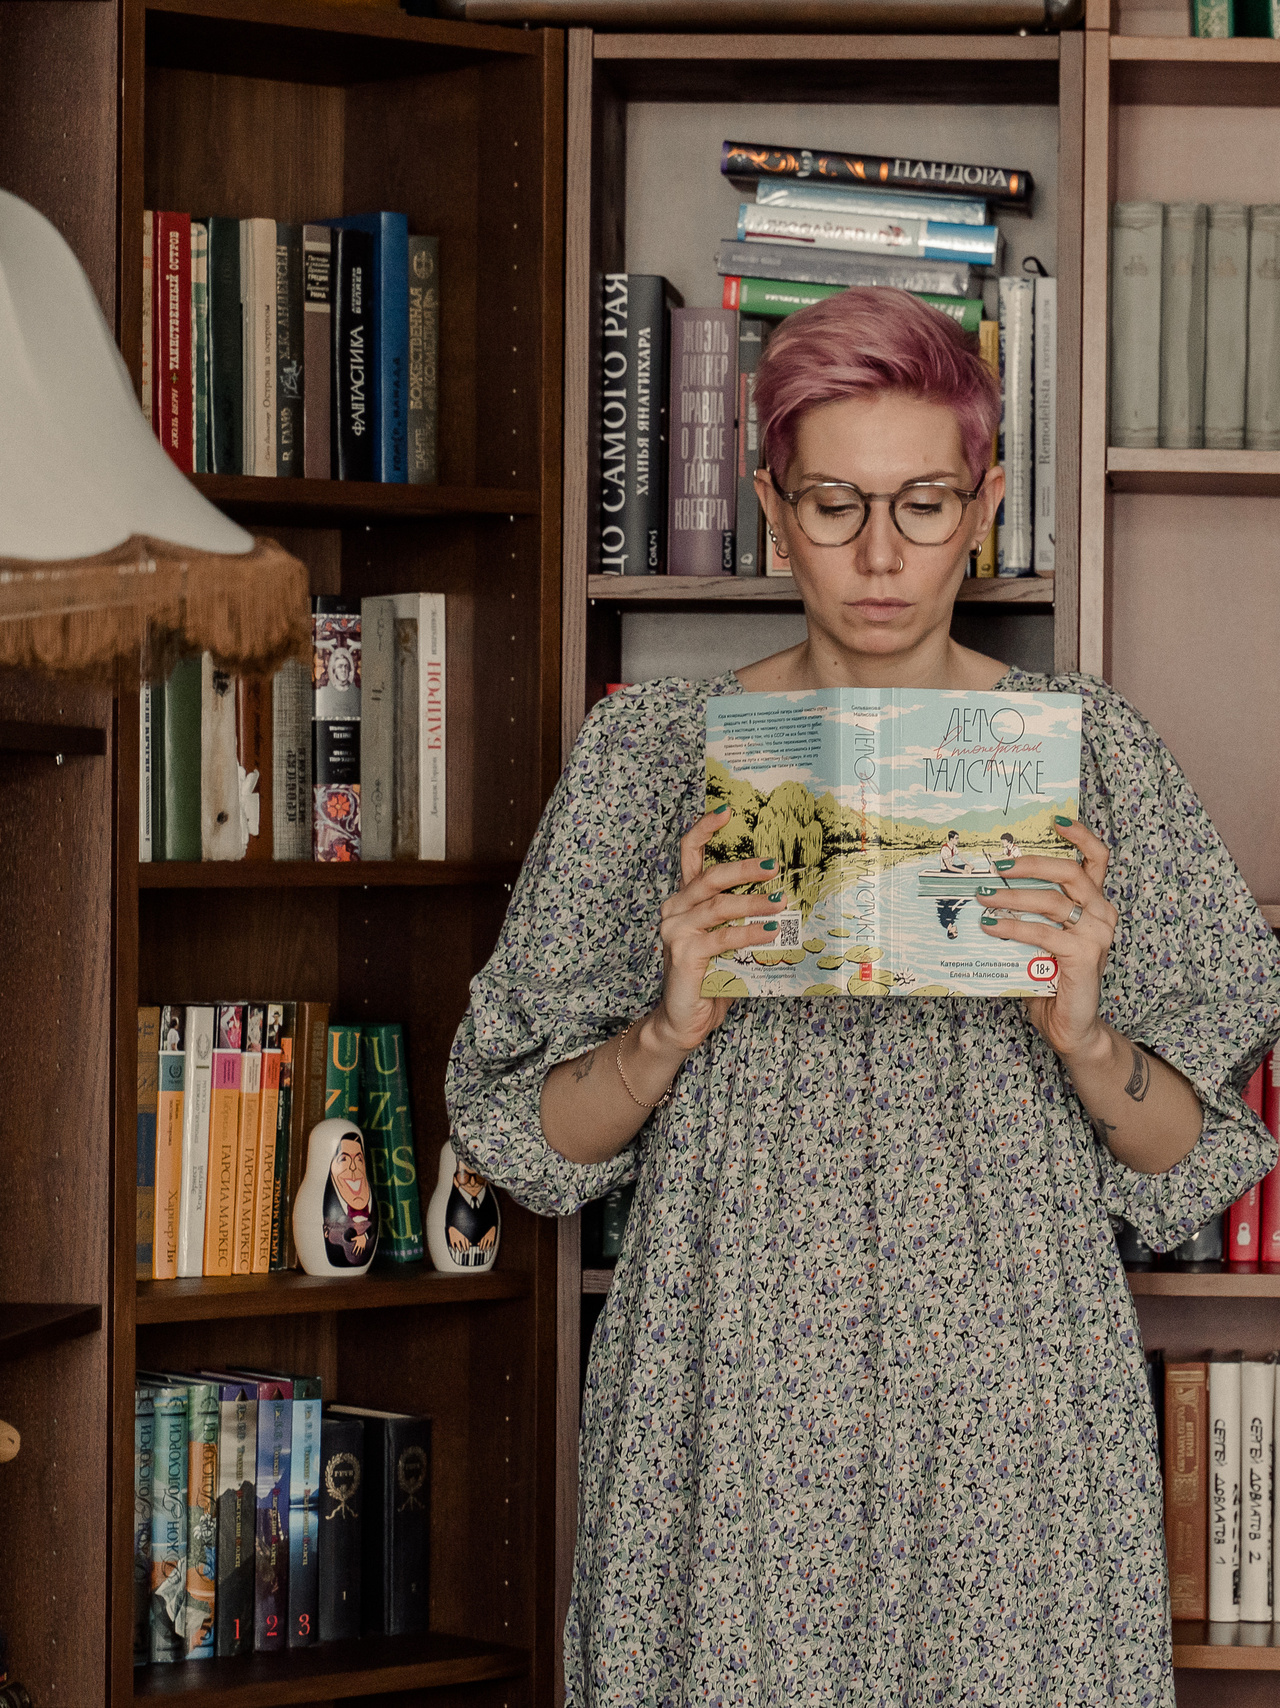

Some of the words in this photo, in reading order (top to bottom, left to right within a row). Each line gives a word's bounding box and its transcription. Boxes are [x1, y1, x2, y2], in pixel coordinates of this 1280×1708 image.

[893, 158, 1007, 187] ПАНДОРА
[169, 230, 179, 271] ОСТРОВ
[277, 245, 289, 327] АНДЕРСЕН
[604, 273, 629, 338] РАЯ
[166, 274, 180, 370] ТАИНСТВЕННЫЙ
[263, 304, 272, 353] островом
[264, 355, 271, 366] за
[410, 287, 423, 410] БОЖЕСТВЕННАЯ
[263, 369, 272, 408] Остров
[350, 325, 366, 436] ФАНТАСТИКА
[637, 326, 652, 431] ЯНАГИХАРА
[171, 389, 179, 415] ВЕРН
[681, 391, 725, 426] ПРАВДА
[1038, 378, 1052, 466] Remodelista
[602, 351, 626, 513] САМОГО
[681, 428, 689, 459] О
[692, 426, 725, 464] ДЕЛЕ
[636, 437, 650, 496] ХАНЬЯ
[684, 464, 720, 494] ГАРРИ
[674, 498, 729, 531] КВЕБЕРТА
[425, 662, 442, 750] БАЙРОН
[943, 708, 1025, 744] ЛЕТО
[854, 724, 875, 780] ЛЕТО
[933, 725, 963, 760] в
[951, 736, 1042, 771] пионерском
[923, 758, 1045, 816] ГАЛСТУКЕ
[940, 960, 973, 968] Катерина
[974, 960, 1020, 968] Сильванова
[949, 970, 971, 978] Елена
[972, 971, 1009, 979] Малисова
[1036, 963, 1050, 975] 18+
[331, 1031, 361, 1072] U
[196, 1165, 204, 1210] Хемингуэй
[221, 1145, 231, 1202] ГАРСИА
[243, 1147, 254, 1205] ГАРСИА
[262, 1144, 274, 1200] ГАРСИА
[164, 1189, 178, 1239] Харпер
[272, 1177, 281, 1219] МАРКЕС
[166, 1242, 177, 1263] Ли
[218, 1205, 229, 1268] МАРКЕС
[240, 1208, 252, 1271] МАРКЕС
[259, 1203, 271, 1266] МАРКЕС
[271, 1222, 279, 1262] ГАРСИА
[1214, 1419, 1227, 1467] СЕРГЕЙ
[1249, 1417, 1264, 1464] СЕРГЕЙ
[1214, 1473, 1226, 1544] ДОВЛАТОВ
[1249, 1468, 1263, 1540] ДОВЛАТОВ
[1215, 1555, 1226, 1565] 1
[1248, 1550, 1261, 1564] 2
[233, 1618, 241, 1640] 1
[265, 1614, 279, 1637] 2
[298, 1613, 311, 1637] 3
